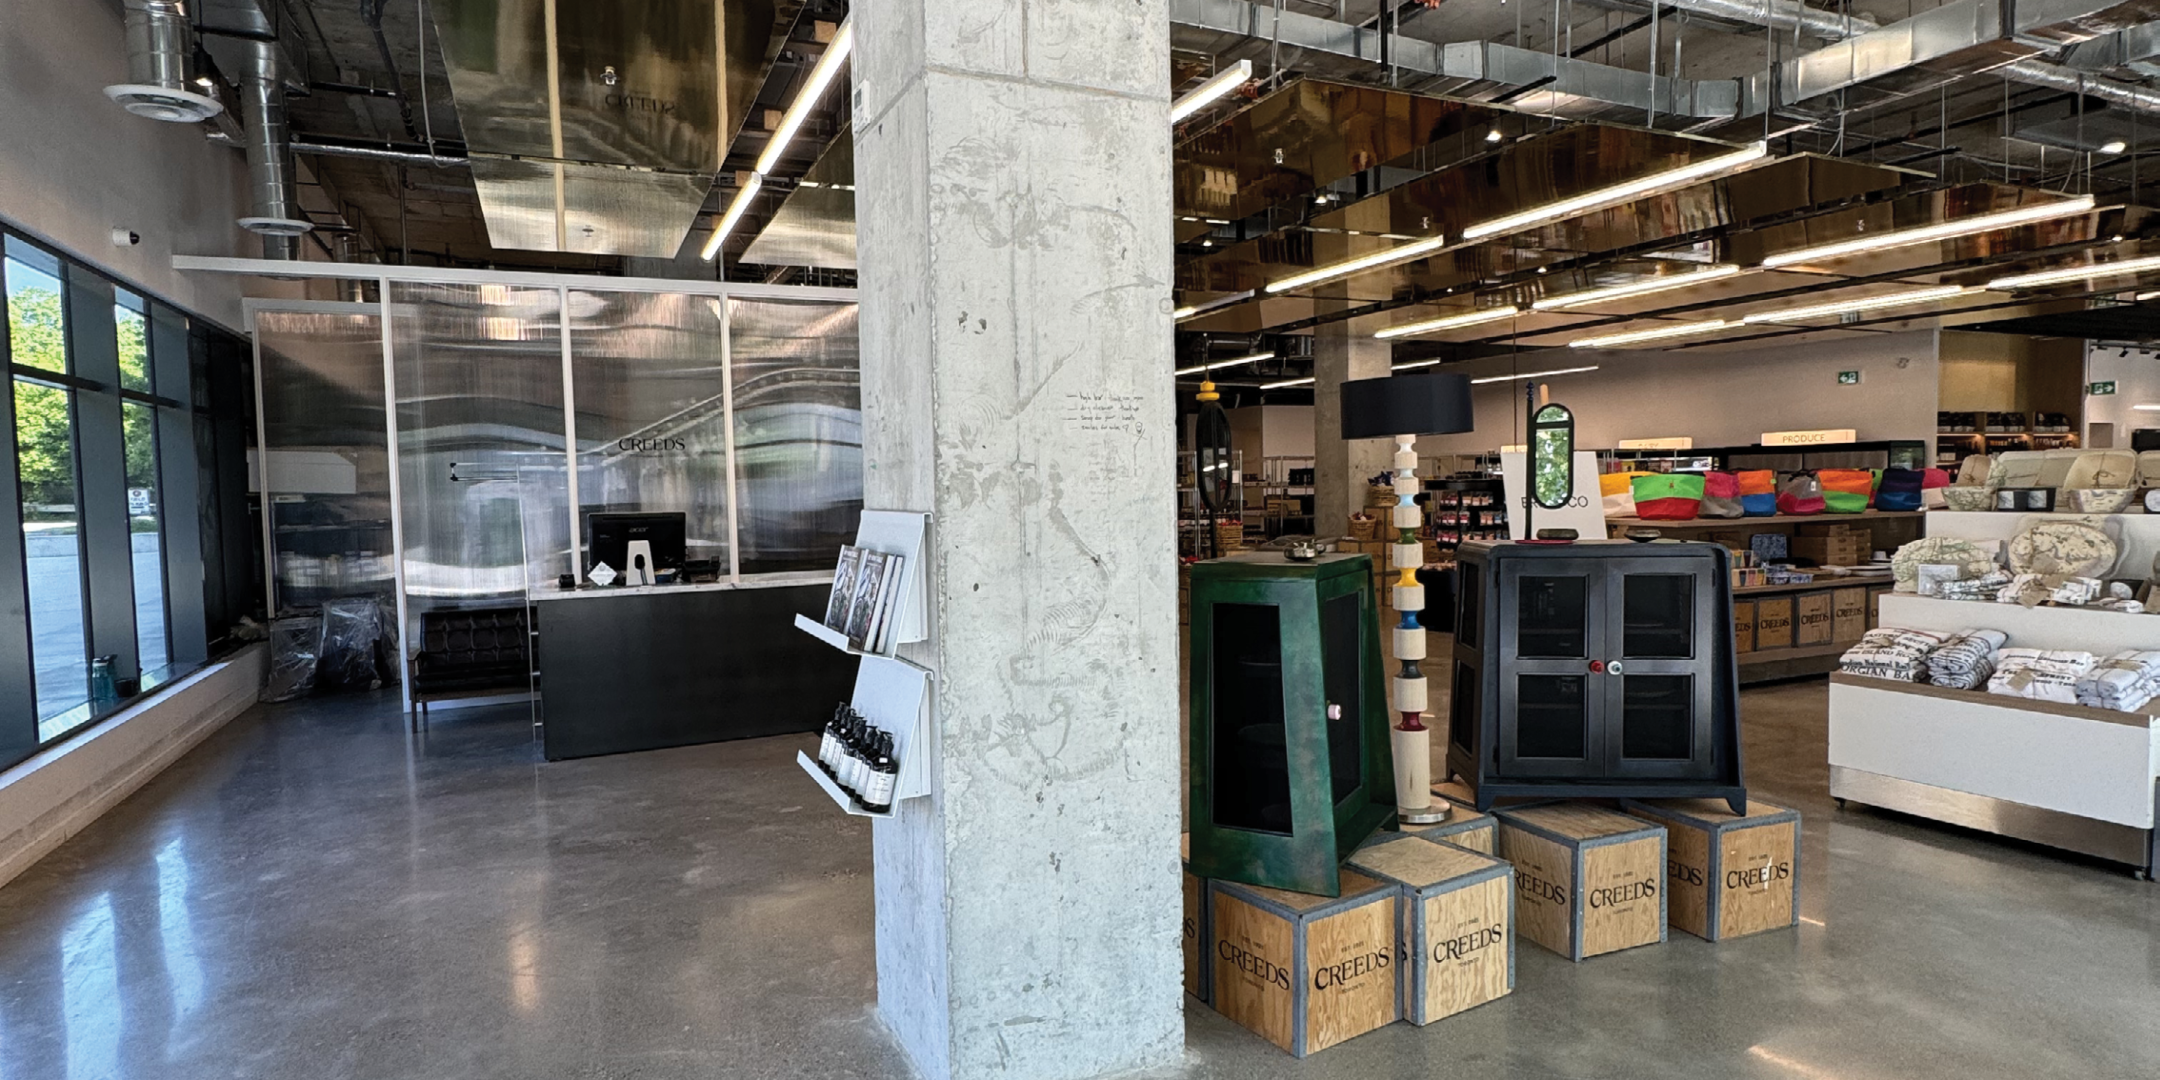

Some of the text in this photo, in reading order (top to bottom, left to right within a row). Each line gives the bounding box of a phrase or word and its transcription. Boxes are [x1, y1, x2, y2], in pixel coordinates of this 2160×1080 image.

[618, 438, 686, 453] CREEDS
[1782, 433, 1826, 444] PRODUCE
[1801, 613, 1829, 625] CREEDS
[1836, 606, 1863, 618] CREEDS
[1735, 622, 1751, 632] EDS
[1760, 618, 1790, 630] CREEDS
[1841, 664, 1911, 680] ORGIAN BA
[1667, 860, 1703, 886] EDS
[1727, 862, 1789, 889] CREEDS
[1515, 868, 1565, 905] REEDS
[1590, 878, 1655, 908] CREEDS
[1433, 923, 1502, 963] CREEDS
[1218, 939, 1290, 991] CREEDS
[1314, 946, 1389, 990] CREEDS
